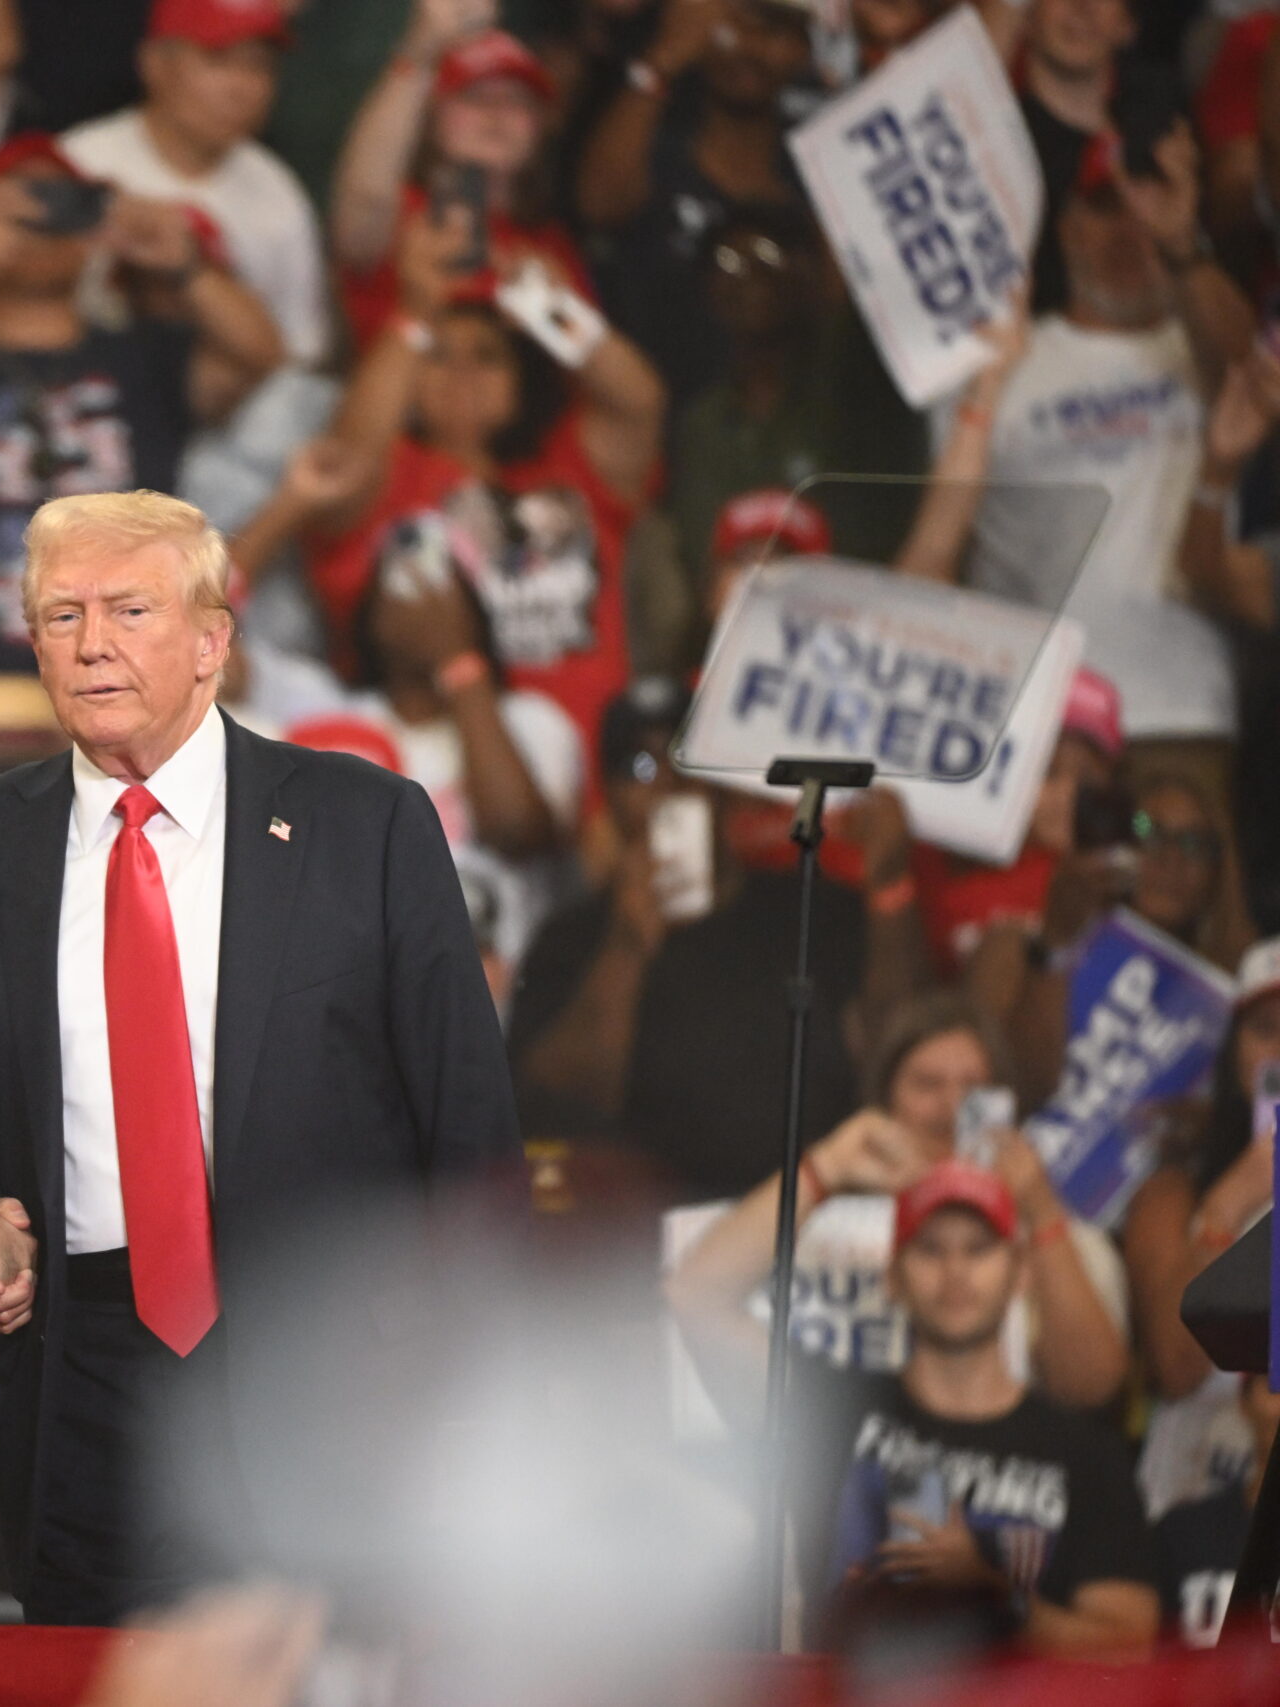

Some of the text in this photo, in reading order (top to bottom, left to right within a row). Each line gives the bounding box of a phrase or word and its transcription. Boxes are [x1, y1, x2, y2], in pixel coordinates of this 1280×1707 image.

[844, 104, 992, 348] FIRED!
[914, 92, 1022, 300] YOU'RE
[734, 660, 1014, 800] FIRED!
[780, 608, 1011, 721] YOU'RE
